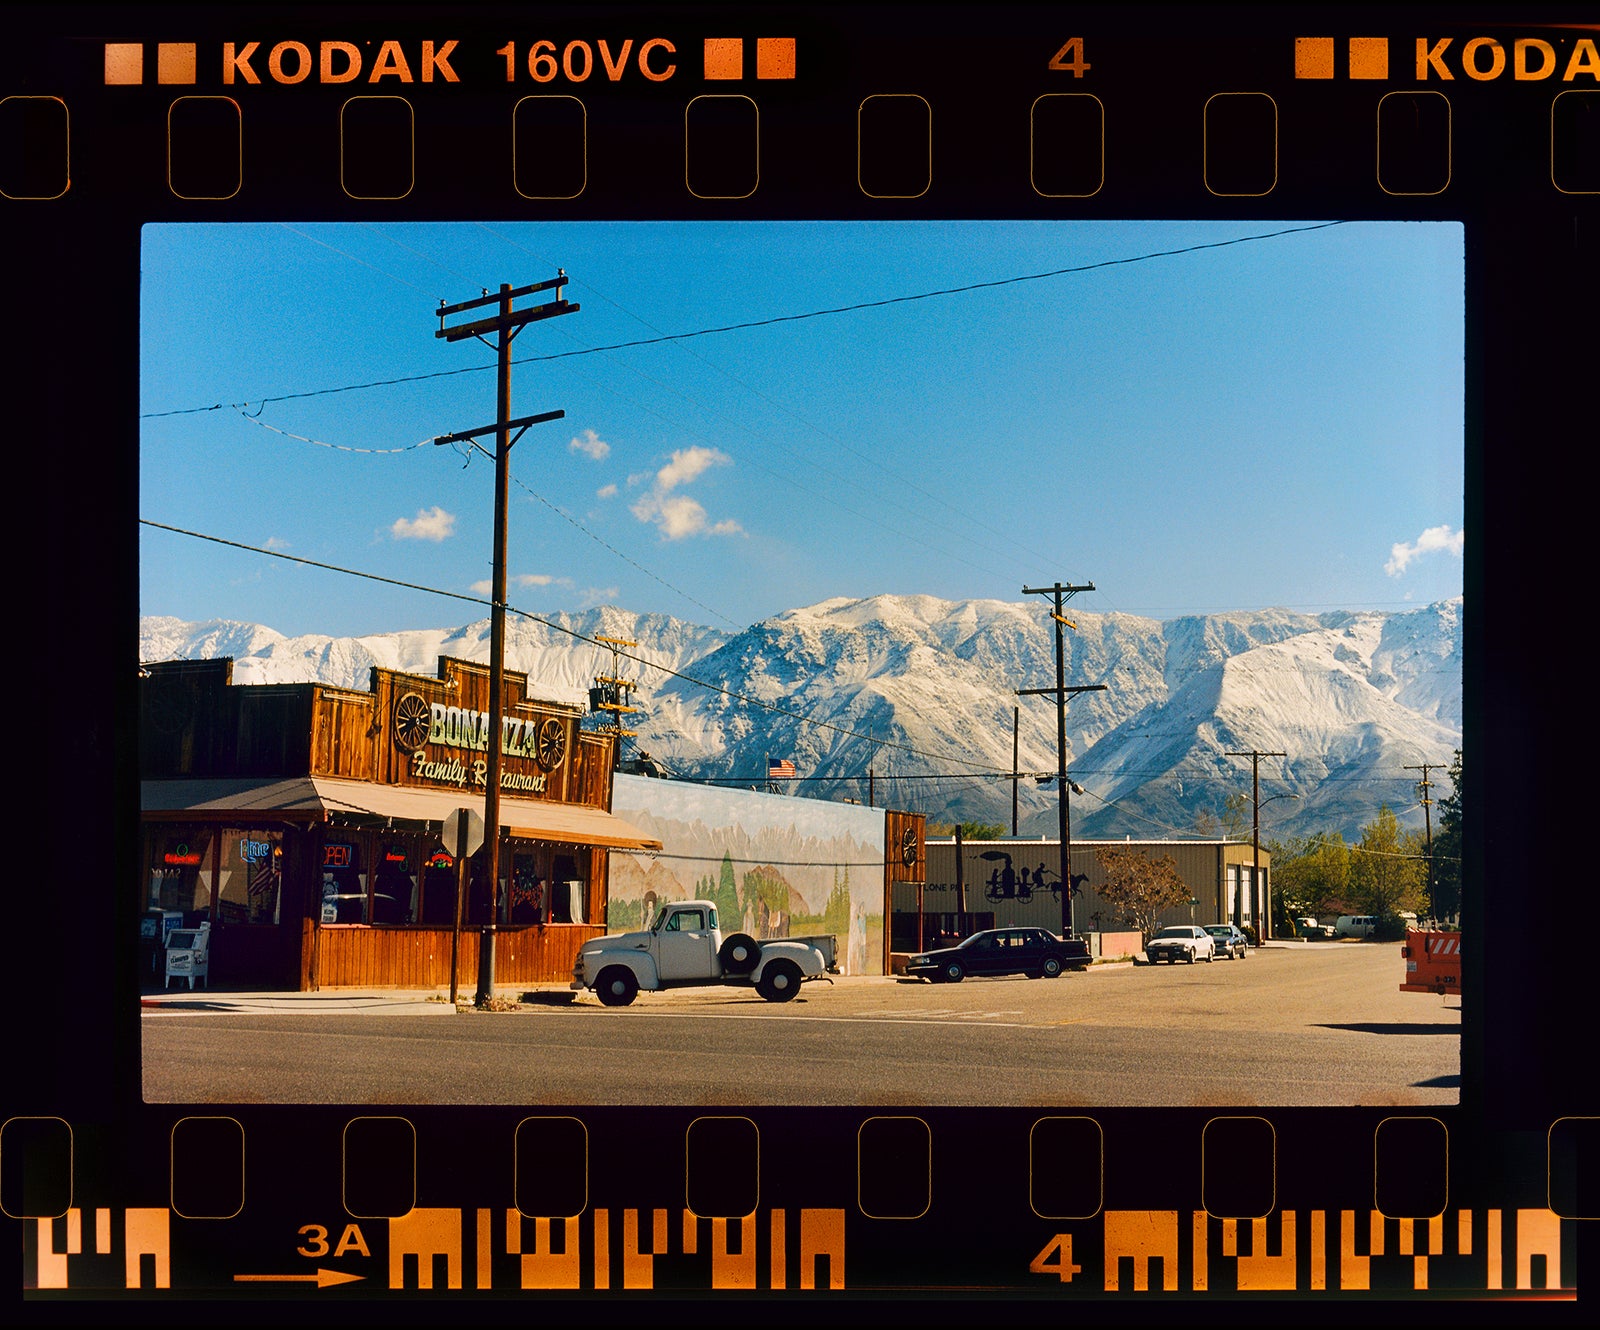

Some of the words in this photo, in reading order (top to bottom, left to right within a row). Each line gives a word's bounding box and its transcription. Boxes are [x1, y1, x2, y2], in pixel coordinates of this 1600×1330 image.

[223, 40, 461, 84] KODAK
[497, 39, 678, 82] 160VC
[1049, 37, 1091, 78] 4
[412, 750, 467, 787] Family
[473, 758, 546, 792] Rtaurant
[924, 883, 947, 892] LONE
[950, 883, 970, 892] PIE
[297, 1224, 371, 1257] 3A
[1029, 1233, 1082, 1283] 4
